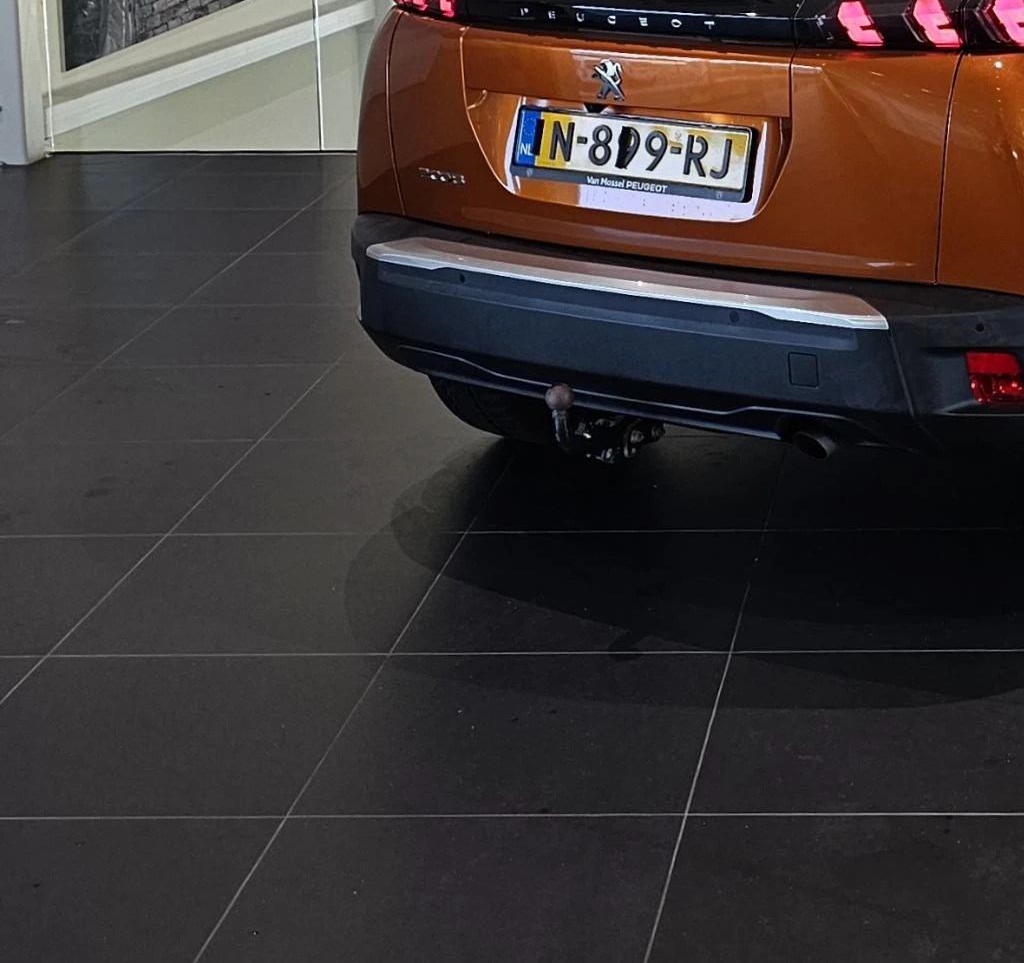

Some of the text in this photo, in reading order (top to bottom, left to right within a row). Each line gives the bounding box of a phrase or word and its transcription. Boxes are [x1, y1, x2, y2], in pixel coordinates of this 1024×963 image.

[586, 175, 668, 193] Van Mossel PEUGEOT
